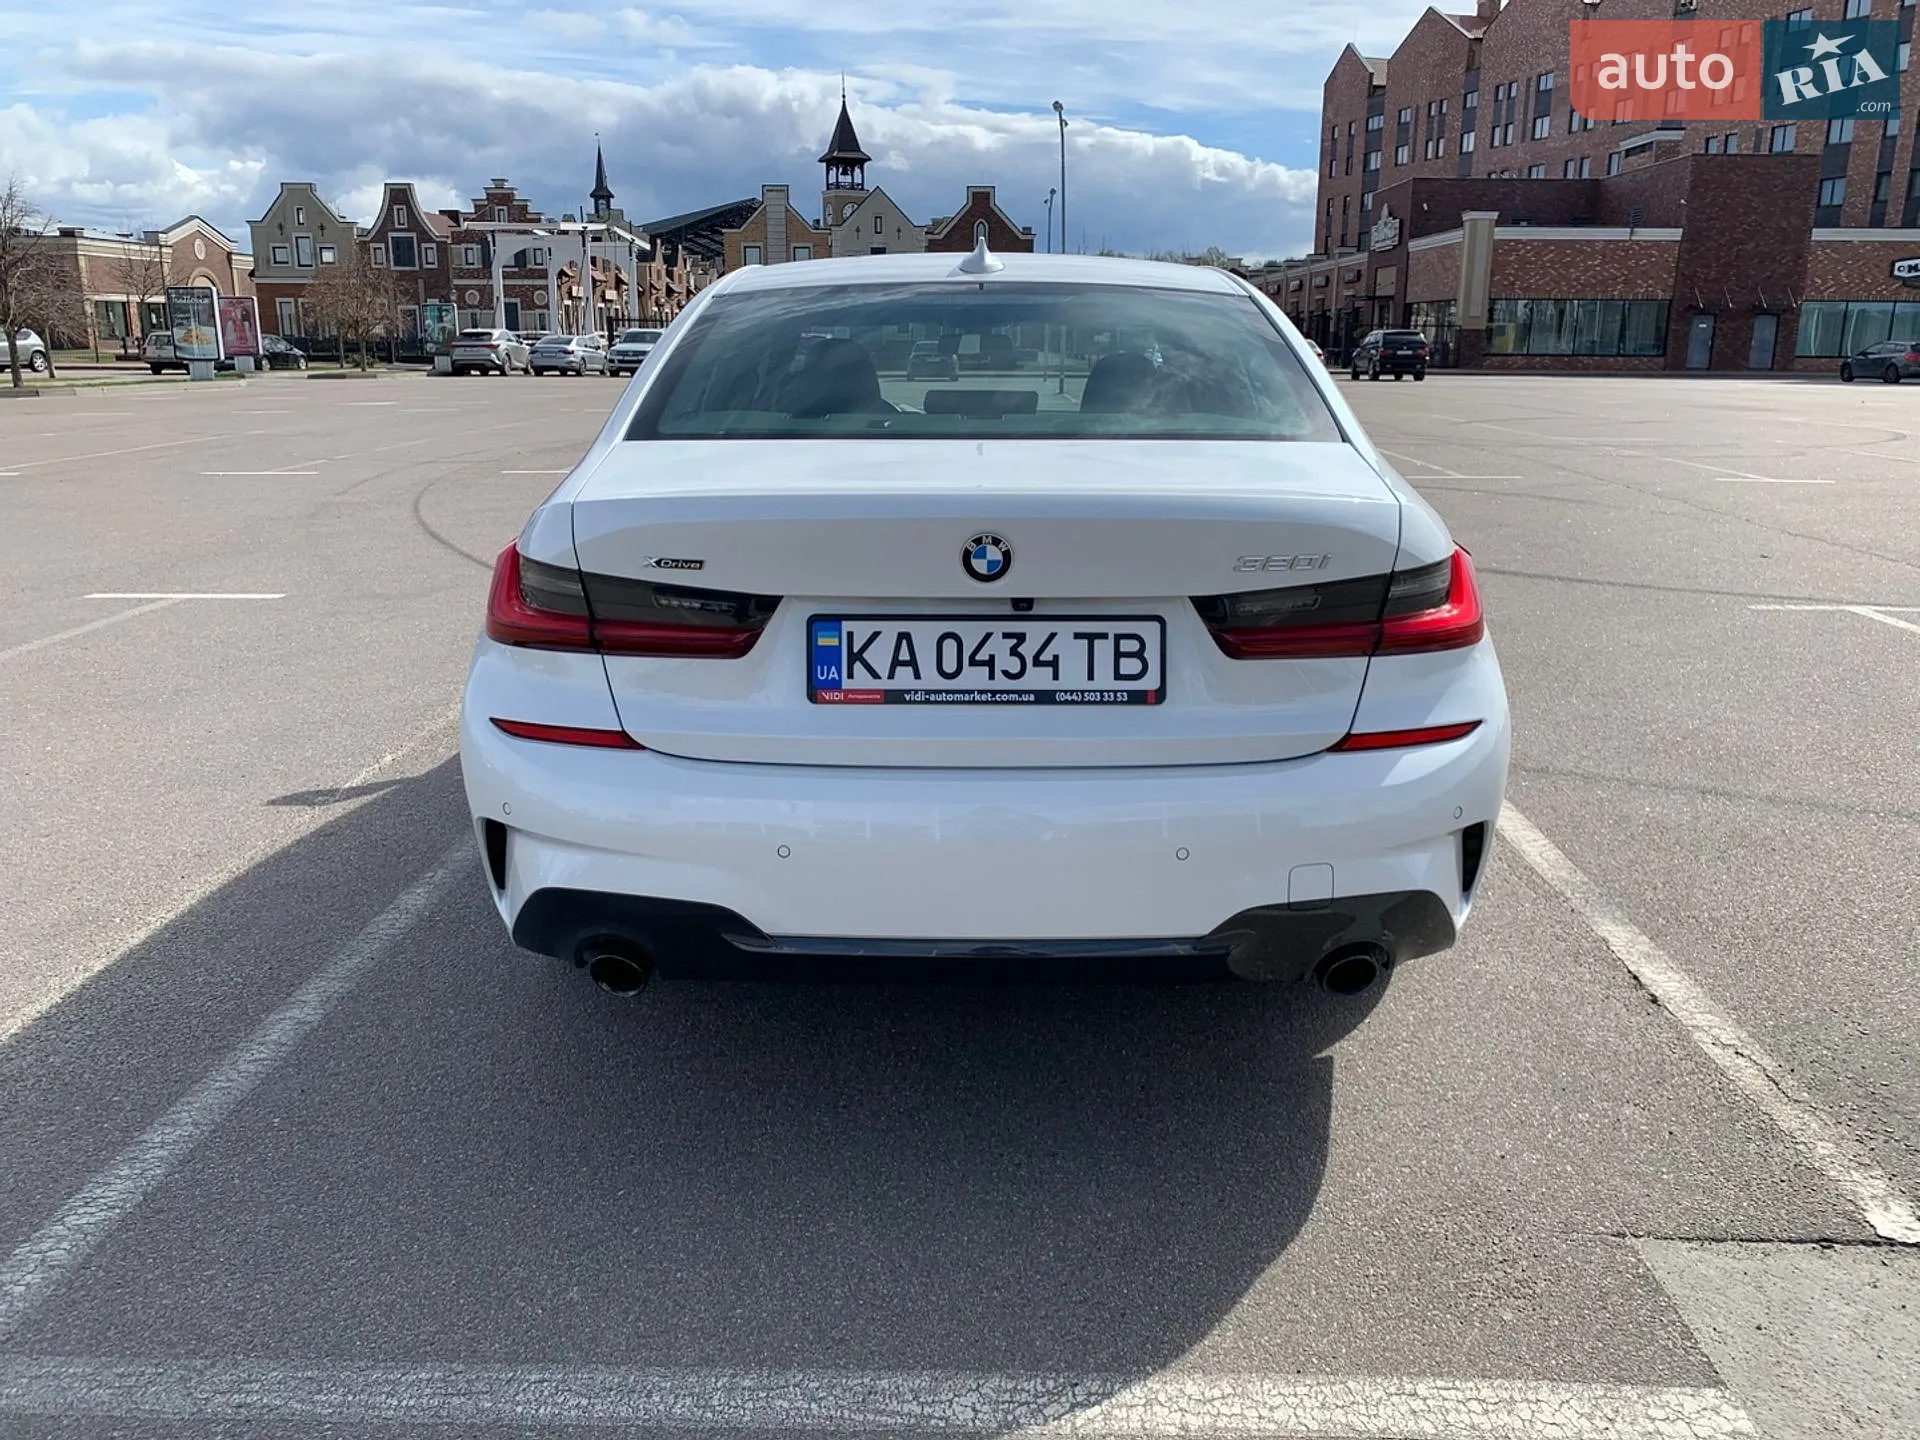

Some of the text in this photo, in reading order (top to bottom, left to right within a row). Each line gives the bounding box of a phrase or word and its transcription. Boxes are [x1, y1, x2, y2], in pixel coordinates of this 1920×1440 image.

[966, 535, 1008, 551] BMW
[817, 665, 839, 680] UA
[904, 691, 1035, 701] vidi-automarket.com.ua
[1084, 692, 1100, 701] 503
[1103, 692, 1114, 701] 33
[1116, 692, 1128, 701] 53
